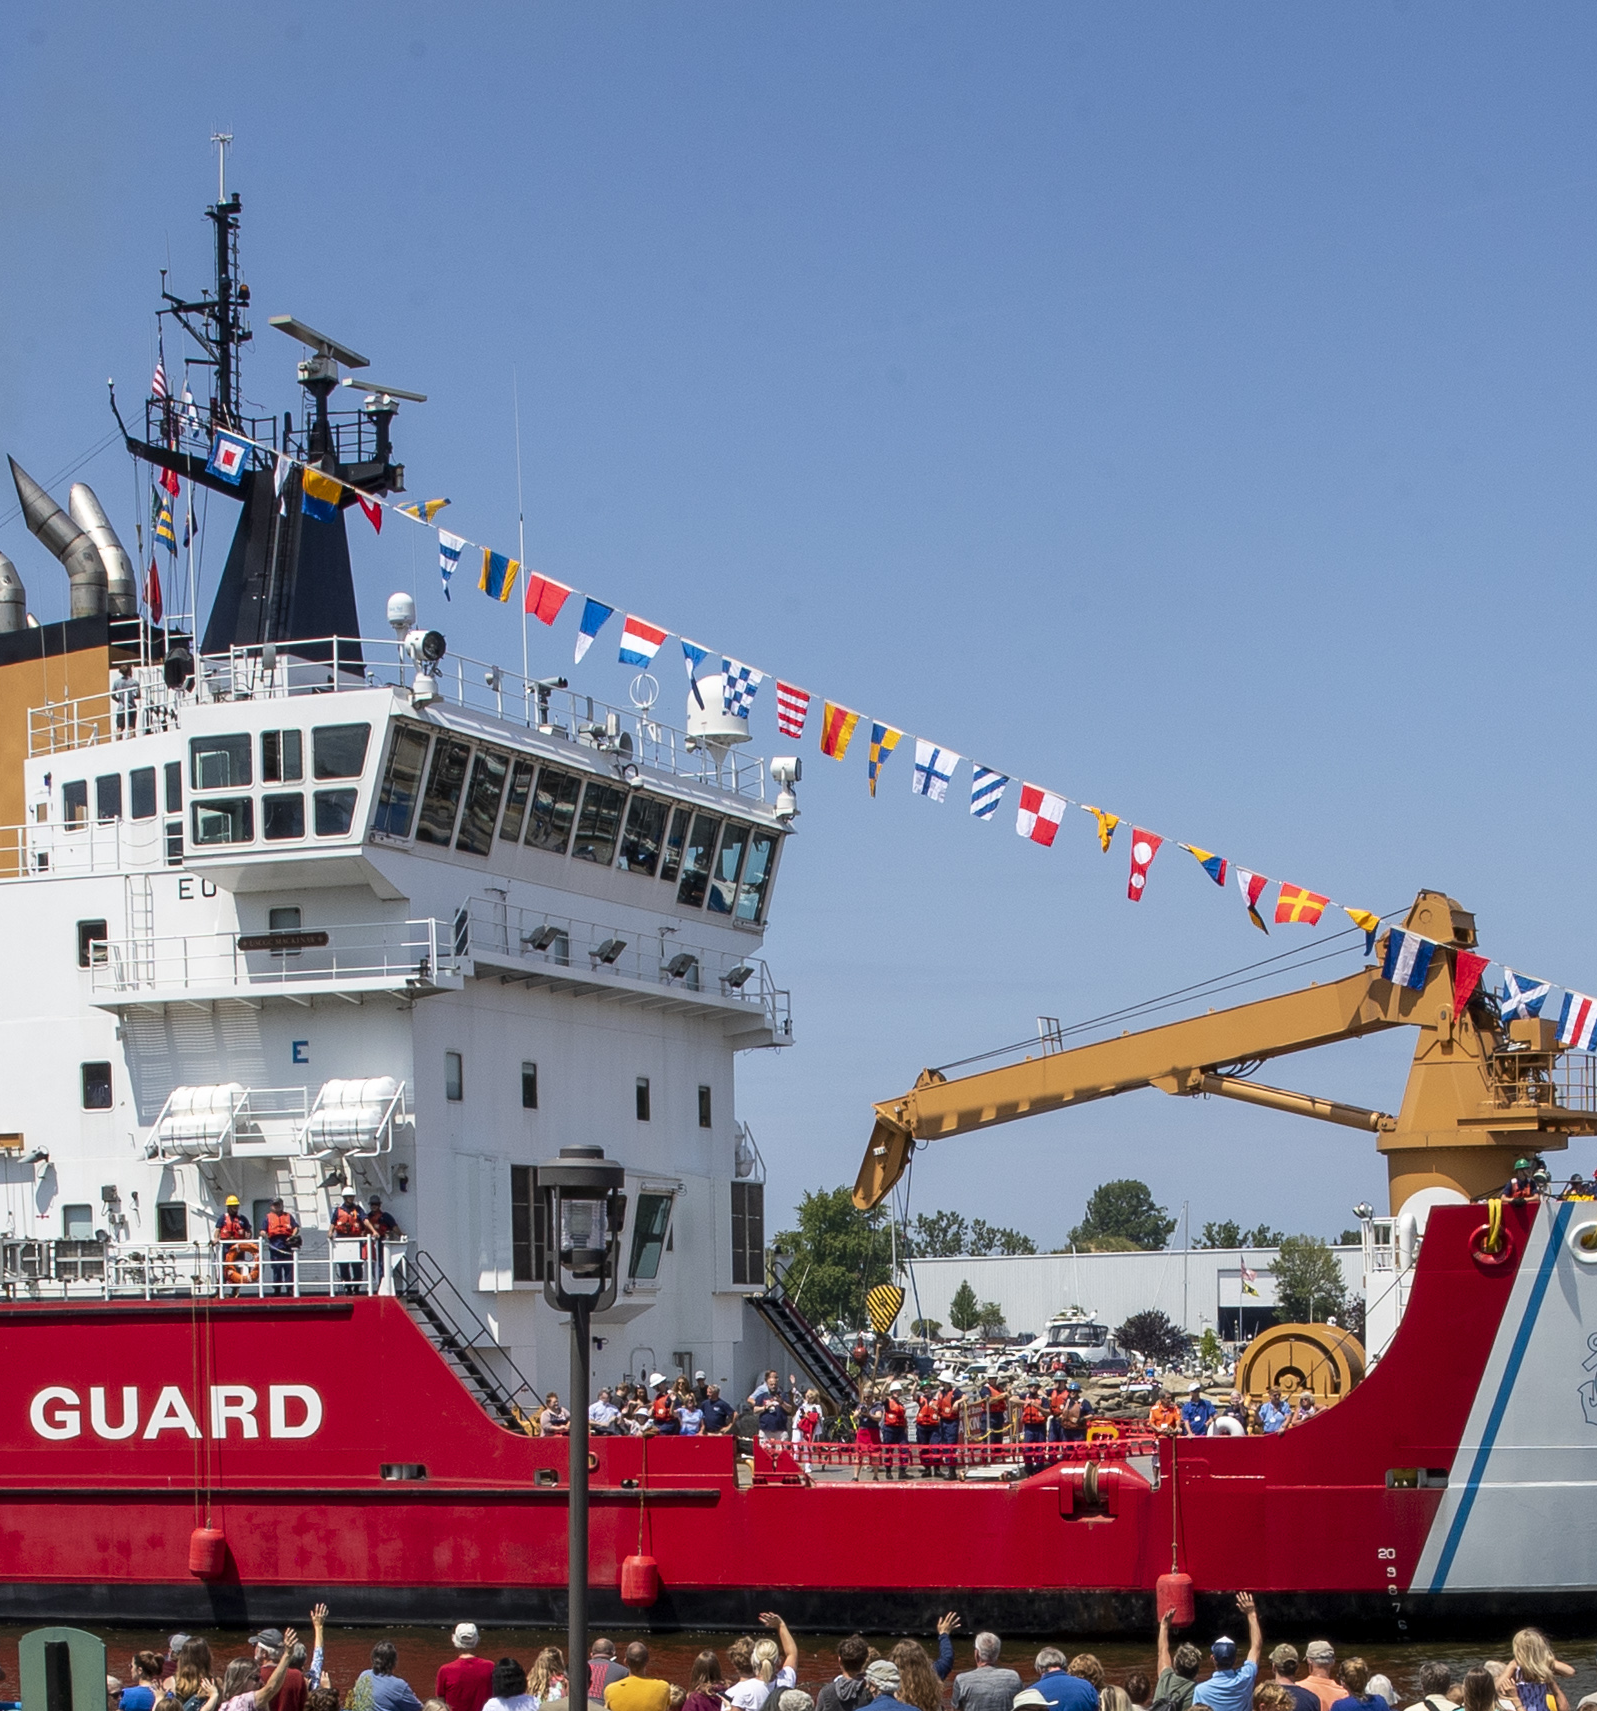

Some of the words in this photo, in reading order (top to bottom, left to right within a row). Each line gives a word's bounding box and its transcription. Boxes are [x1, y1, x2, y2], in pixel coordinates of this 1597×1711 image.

[292, 1040, 310, 1064] E
[30, 1385, 322, 1440] GUARD
[1377, 1548, 1396, 1559] 20
[1386, 1566, 1397, 1578] 9
[1392, 1603, 1401, 1613] 7
